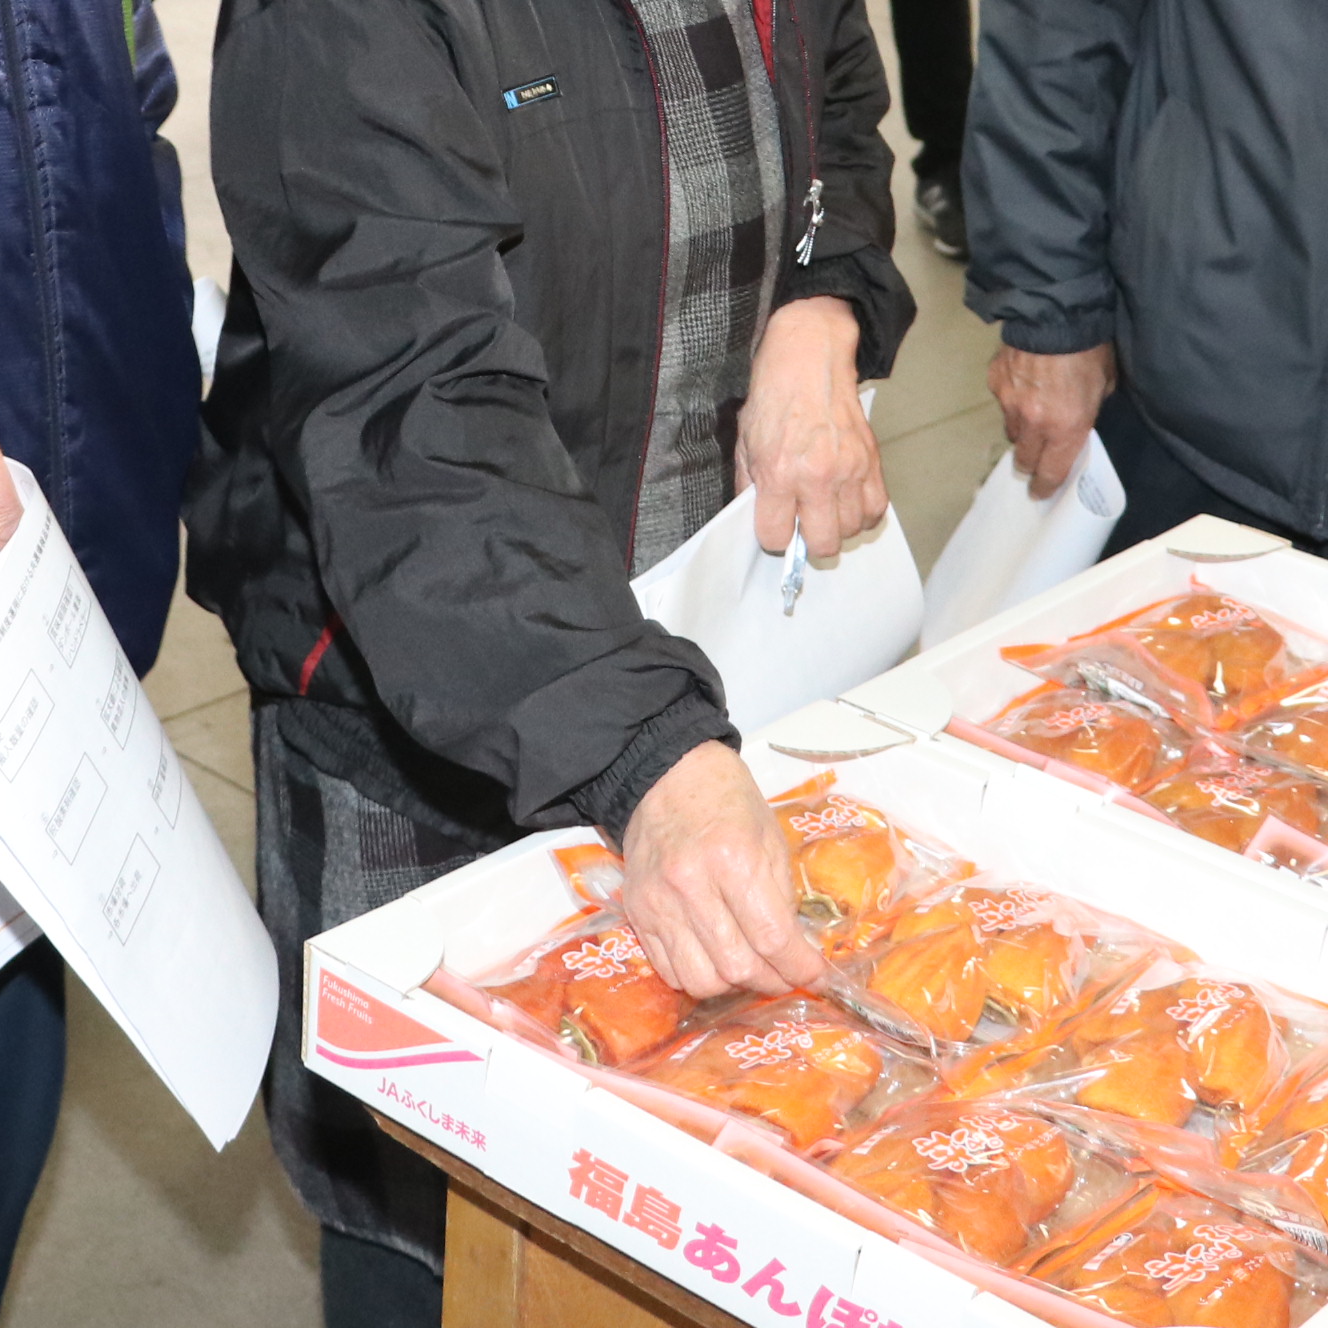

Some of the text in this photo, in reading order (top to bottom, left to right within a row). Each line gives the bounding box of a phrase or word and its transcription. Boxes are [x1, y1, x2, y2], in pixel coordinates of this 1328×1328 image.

[322, 974, 370, 1009] Fukushima
[322, 988, 374, 1025] Fresh Fruits
[377, 1076, 488, 1152] JAふくしま未来
[568, 1148, 905, 1328] 福島あんぽ
